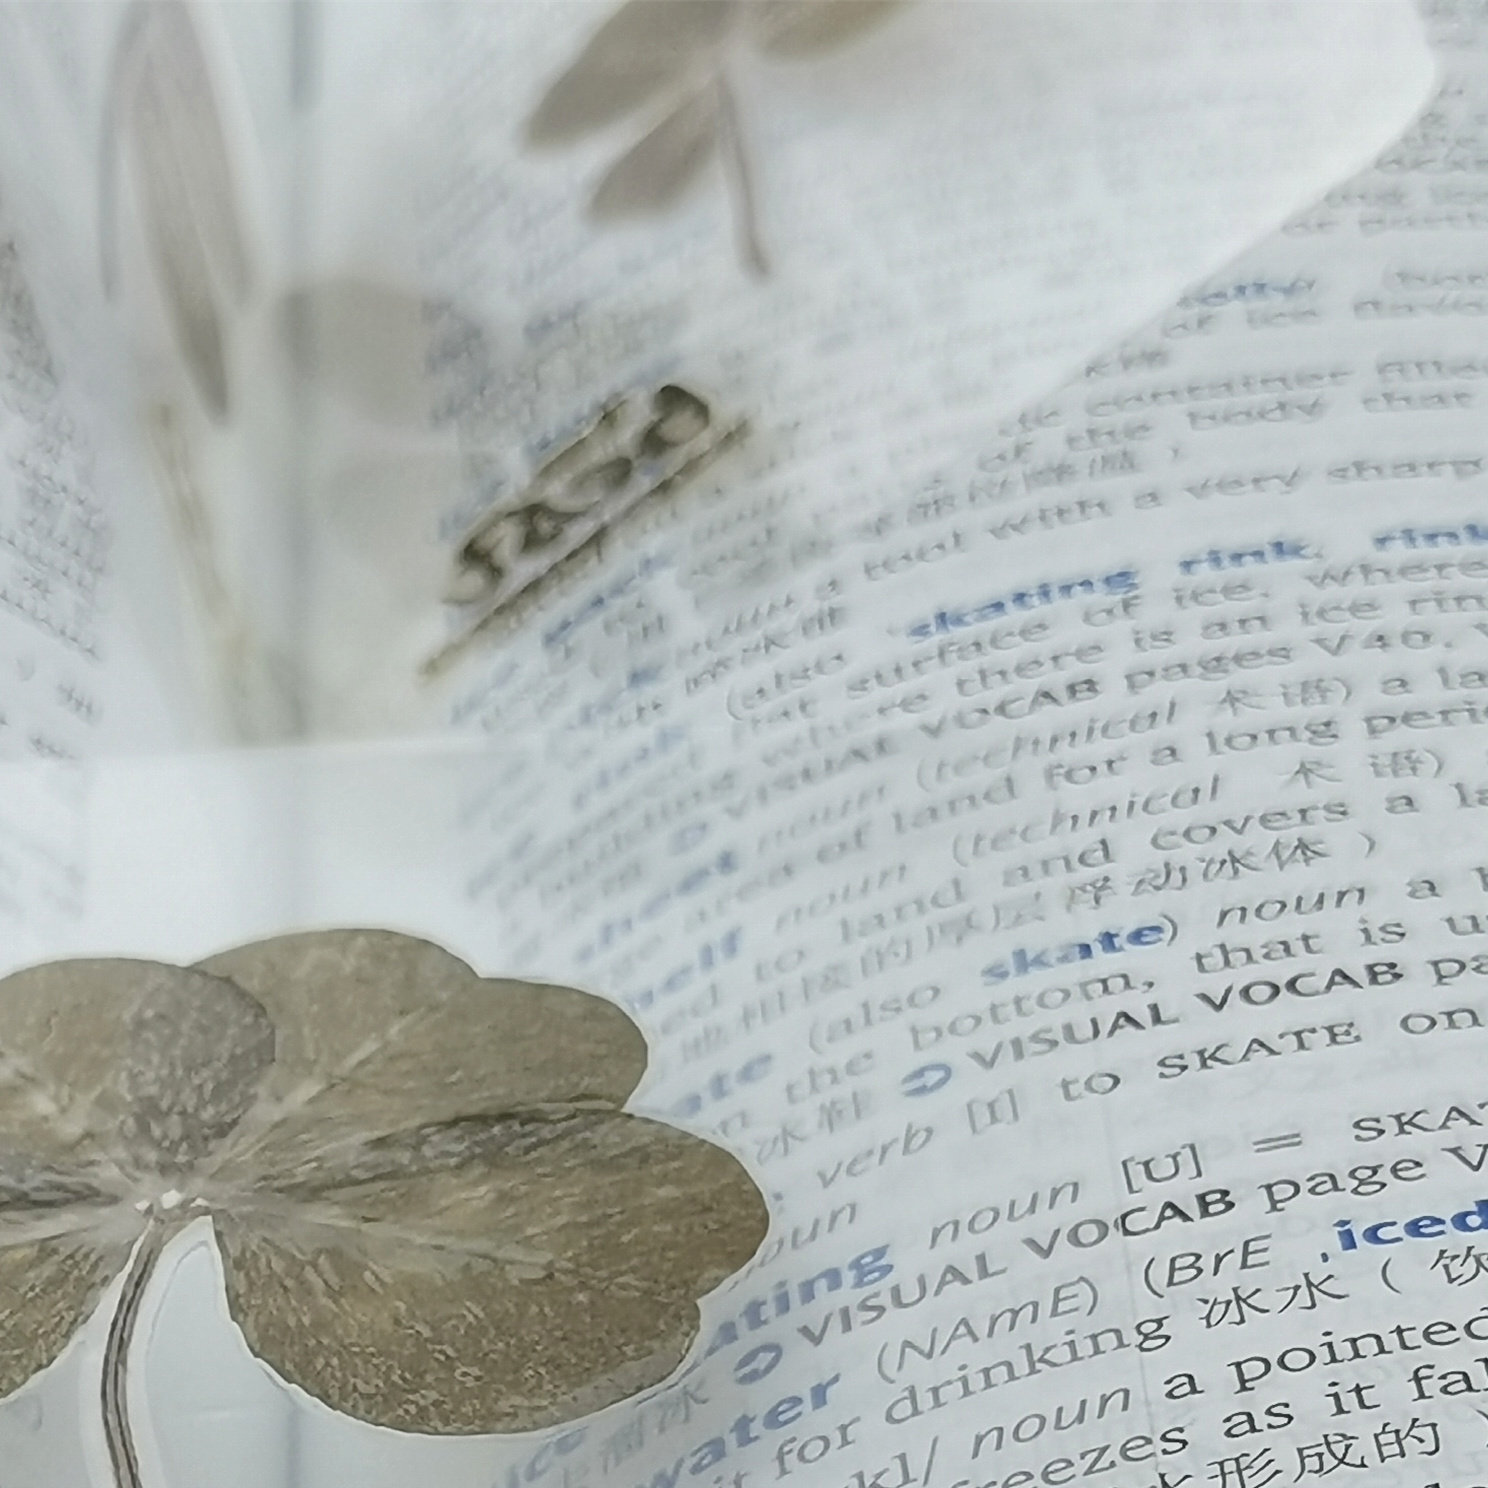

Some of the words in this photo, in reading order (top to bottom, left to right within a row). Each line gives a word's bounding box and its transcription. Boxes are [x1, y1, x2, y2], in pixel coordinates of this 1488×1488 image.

[1125, 644, 1295, 693] pages
[1207, 720, 1340, 756] long
[1150, 799, 1351, 851] covers
[1383, 793, 1420, 814] a
[980, 914, 1178, 985] skate)
[1216, 884, 1366, 928] noun
[1406, 878, 1442, 901] a
[1191, 930, 1323, 975] that
[1357, 917, 1406, 947] is
[965, 1003, 1180, 1071] VISUAL
[1193, 962, 1404, 1013] VOCAB
[817, 1122, 933, 1190] verb
[1060, 1071, 1122, 1102] to
[1156, 1020, 1362, 1079] SKATE
[1398, 1007, 1488, 1035] on
[928, 1180, 1080, 1250] noun
[1121, 1143, 1204, 1194] [U]
[797, 1252, 1008, 1348] VISUAL
[1021, 1188, 1236, 1260] VOCAB
[1257, 1157, 1428, 1214] page
[877, 1276, 1100, 1384] (NAmE)
[1143, 1233, 1273, 1298] (BrE
[774, 1416, 863, 1480] for
[884, 1314, 1173, 1425] drinking
[971, 1385, 1131, 1460] noun
[1163, 1372, 1205, 1400] a
[1222, 1401, 1295, 1439] as
[1324, 1380, 1381, 1417] it
